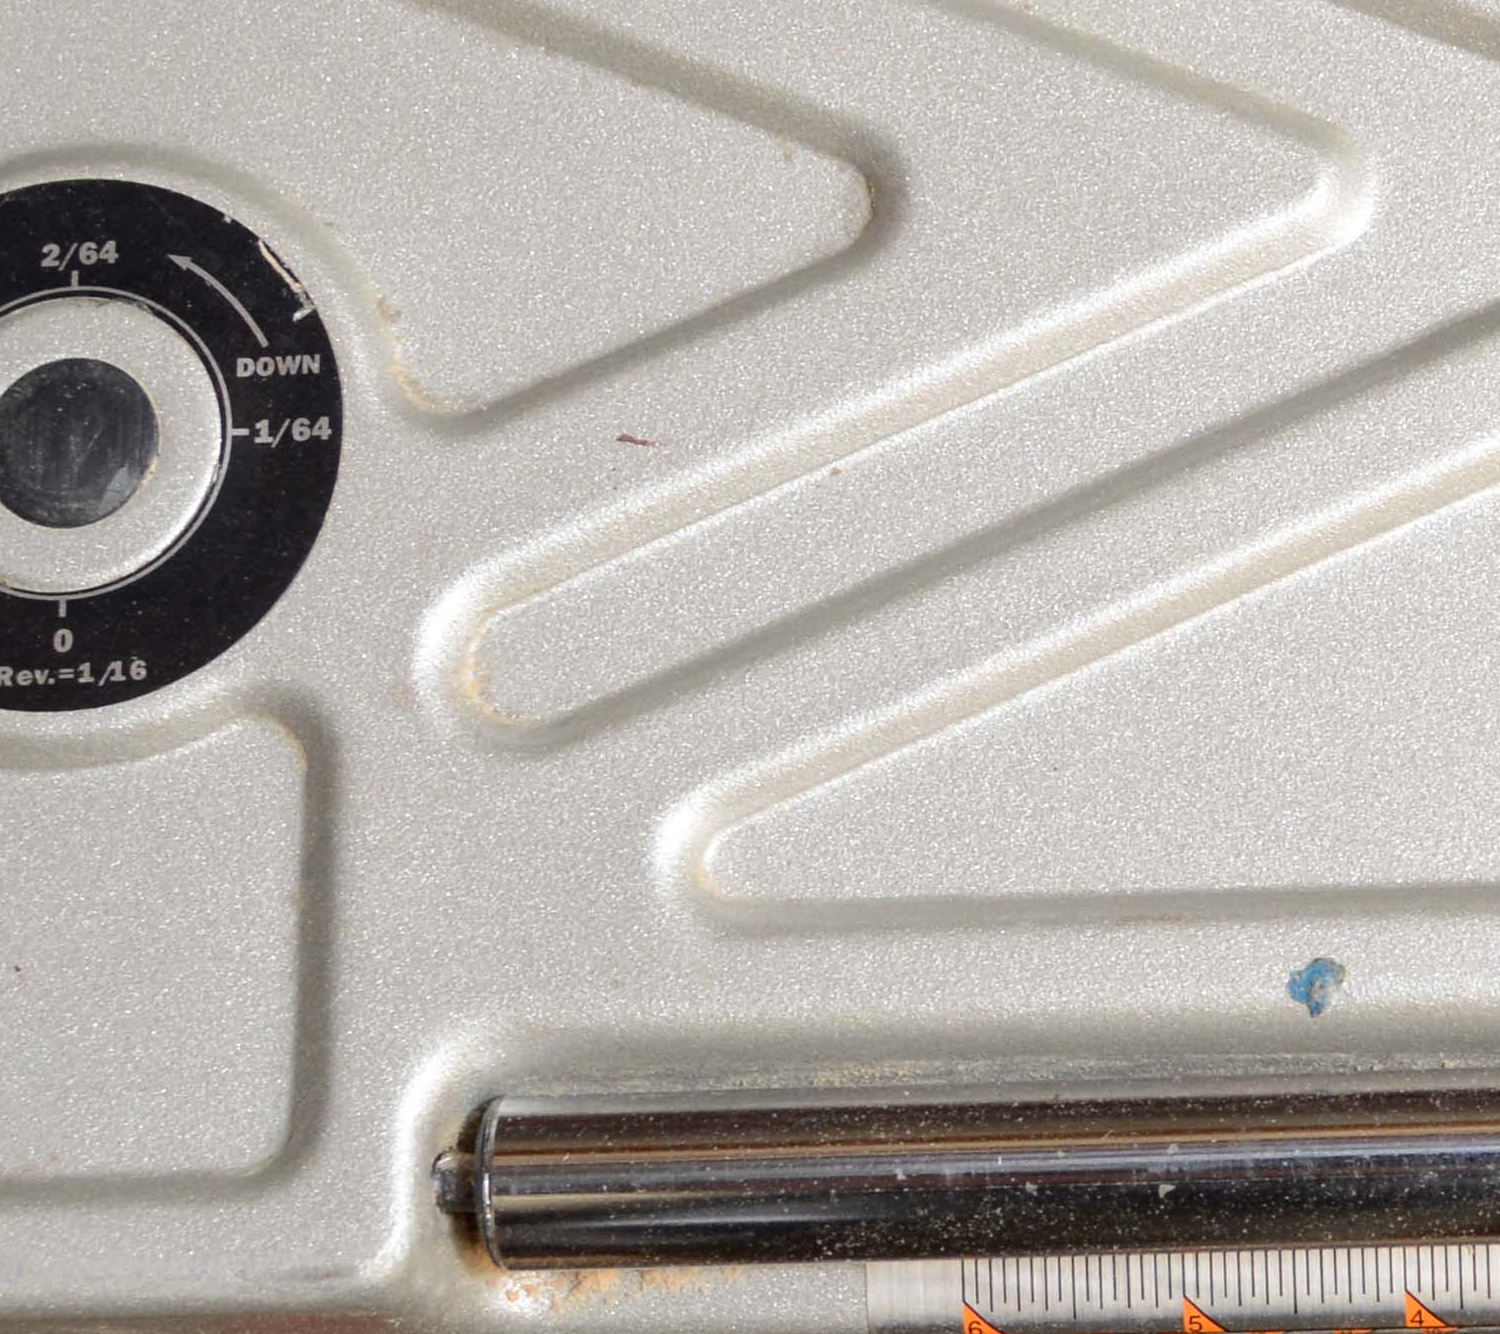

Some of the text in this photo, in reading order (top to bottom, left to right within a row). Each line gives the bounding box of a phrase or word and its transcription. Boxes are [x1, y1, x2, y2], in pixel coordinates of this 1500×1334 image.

[41, 241, 118, 270] 2/64
[236, 355, 321, 379] DOWN
[255, 417, 332, 445] 1/64
[54, 628, 73, 653] 0
[1189, 1315, 1203, 1332] 5
[1410, 1309, 1425, 1326] 4
